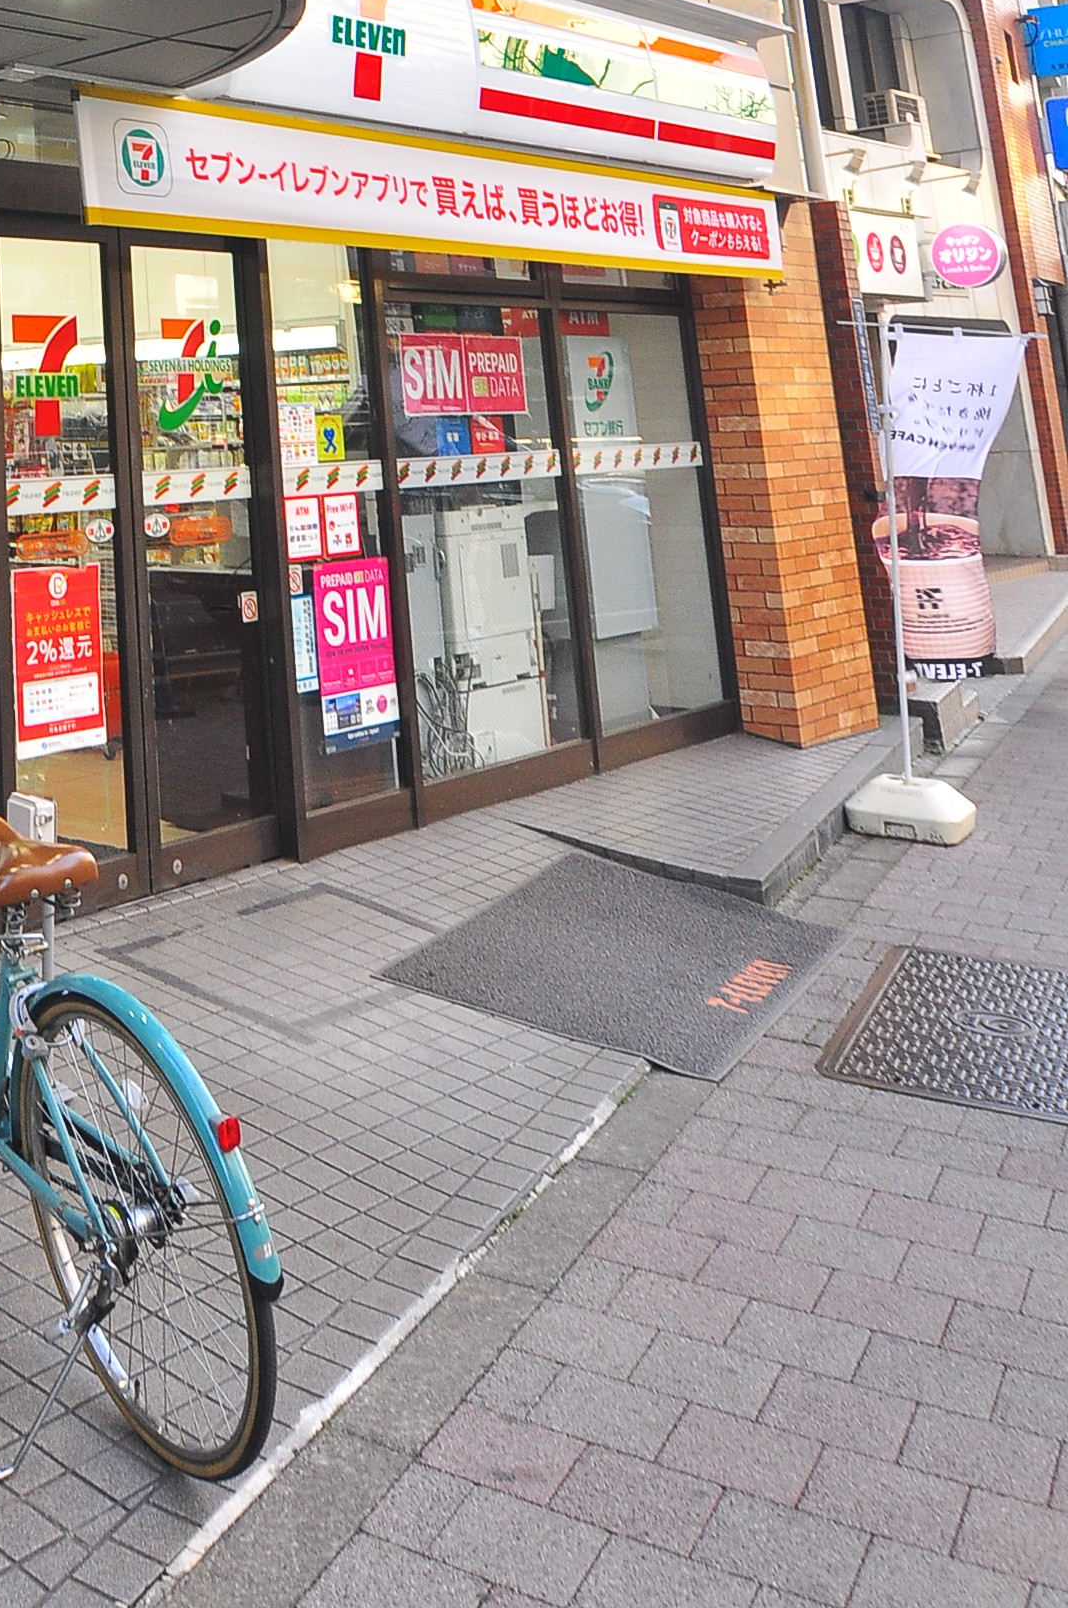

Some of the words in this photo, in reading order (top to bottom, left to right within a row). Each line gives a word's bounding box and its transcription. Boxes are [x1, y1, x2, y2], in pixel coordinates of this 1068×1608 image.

[945, 234, 980, 246] キッチン
[938, 247, 992, 264] オリジン
[187, 358, 232, 372] HOLDINGS
[468, 351, 518, 374] PREPAID
[403, 348, 463, 401] SIM
[489, 376, 520, 398] DATA
[295, 507, 310, 517] ATM
[320, 572, 353, 589] PREPAID
[364, 569, 384, 584] DATA
[26, 606, 91, 624] キャッシュレスで
[322, 585, 388, 648] SIM
[25, 635, 93, 666] 2%還元
